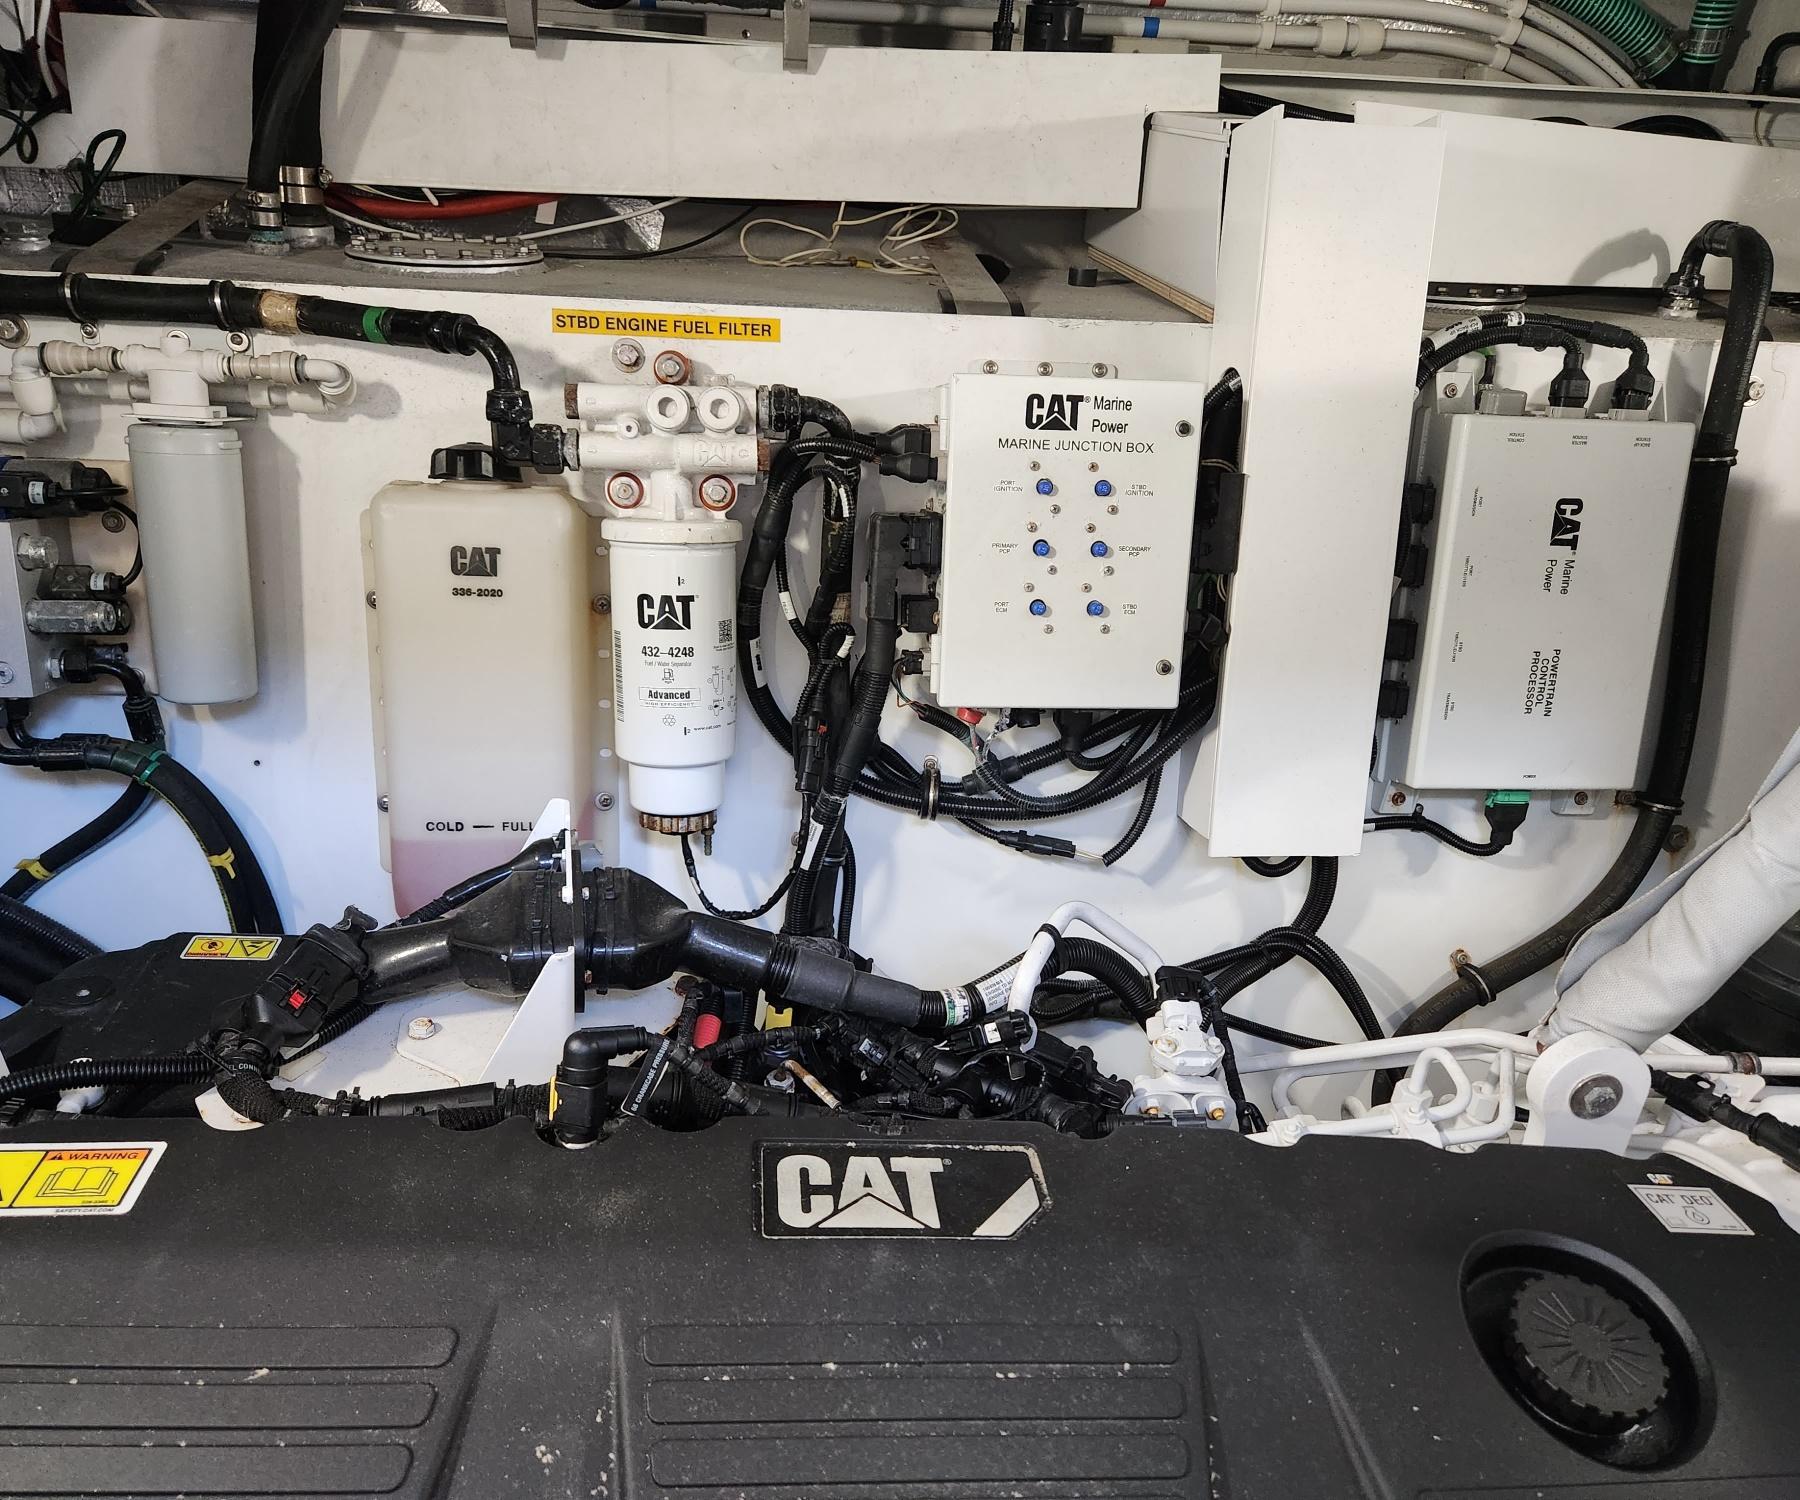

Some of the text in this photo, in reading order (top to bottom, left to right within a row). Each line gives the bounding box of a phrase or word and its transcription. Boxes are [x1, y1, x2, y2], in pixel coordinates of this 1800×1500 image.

[555, 314, 772, 337] STBD ENGINE FUEL FILTER
[1025, 393, 1133, 431] CAT Marine
[1091, 419, 1129, 434] Power
[998, 438, 1154, 454] MARINE JUNCTION BOX
[1549, 498, 1584, 551] CAT
[450, 545, 502, 577] CAT
[1543, 559, 1558, 593] Power
[1560, 559, 1576, 595] Marine
[452, 587, 503, 598] 336-2020
[637, 593, 695, 631] CAT
[644, 660, 654, 668] Fuel
[657, 660, 670, 668] Water
[648, 689, 691, 700] Advanced
[1523, 650, 1541, 715] PROCESSOR
[1534, 658, 1550, 708] CONTROL
[1543, 648, 1562, 717] POWERTRAIN
[425, 821, 534, 832] COLD FULL
[635, 1068, 657, 1104] CRANKCASE
[69, 1152, 138, 1160] WARNING
[776, 1154, 944, 1229] CAT
[1646, 1192, 1714, 1206] CAT DEO
